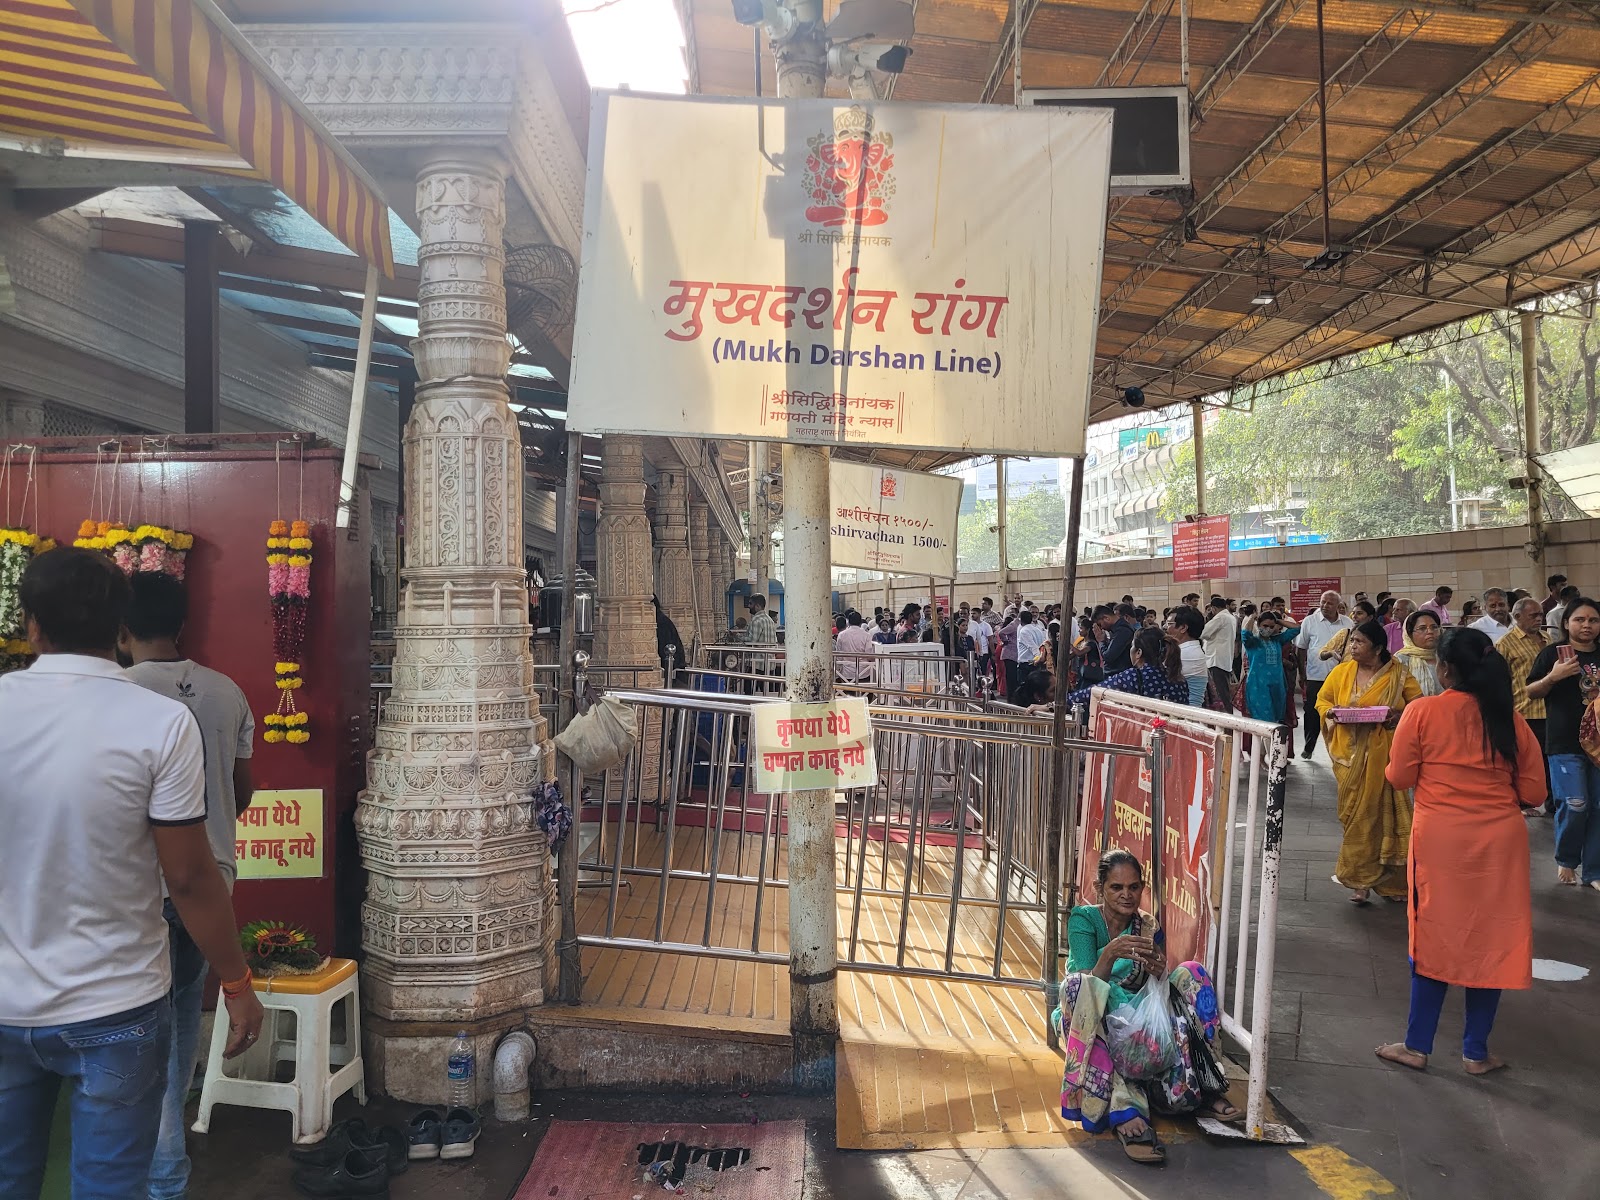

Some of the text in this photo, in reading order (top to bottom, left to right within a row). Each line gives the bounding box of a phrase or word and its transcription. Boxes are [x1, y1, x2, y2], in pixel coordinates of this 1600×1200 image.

[798, 229, 813, 243] श्री
[663, 267, 1009, 341] मुखदर्शन रांग
[712, 337, 1001, 378] (Mukh Darshan Line)
[770, 411, 894, 428] गणपती मंदिर न्यास
[836, 506, 934, 531] आशीर्वचन १५००/-
[830, 525, 947, 550] shirvachan 1500/-
[776, 709, 851, 747] कृपया येथे
[763, 741, 865, 776] चप्पल काढू नये
[238, 800, 302, 827] पया येथे
[250, 839, 289, 867] काढू
[288, 832, 316, 859] नये
[1171, 876, 1197, 919] Line
